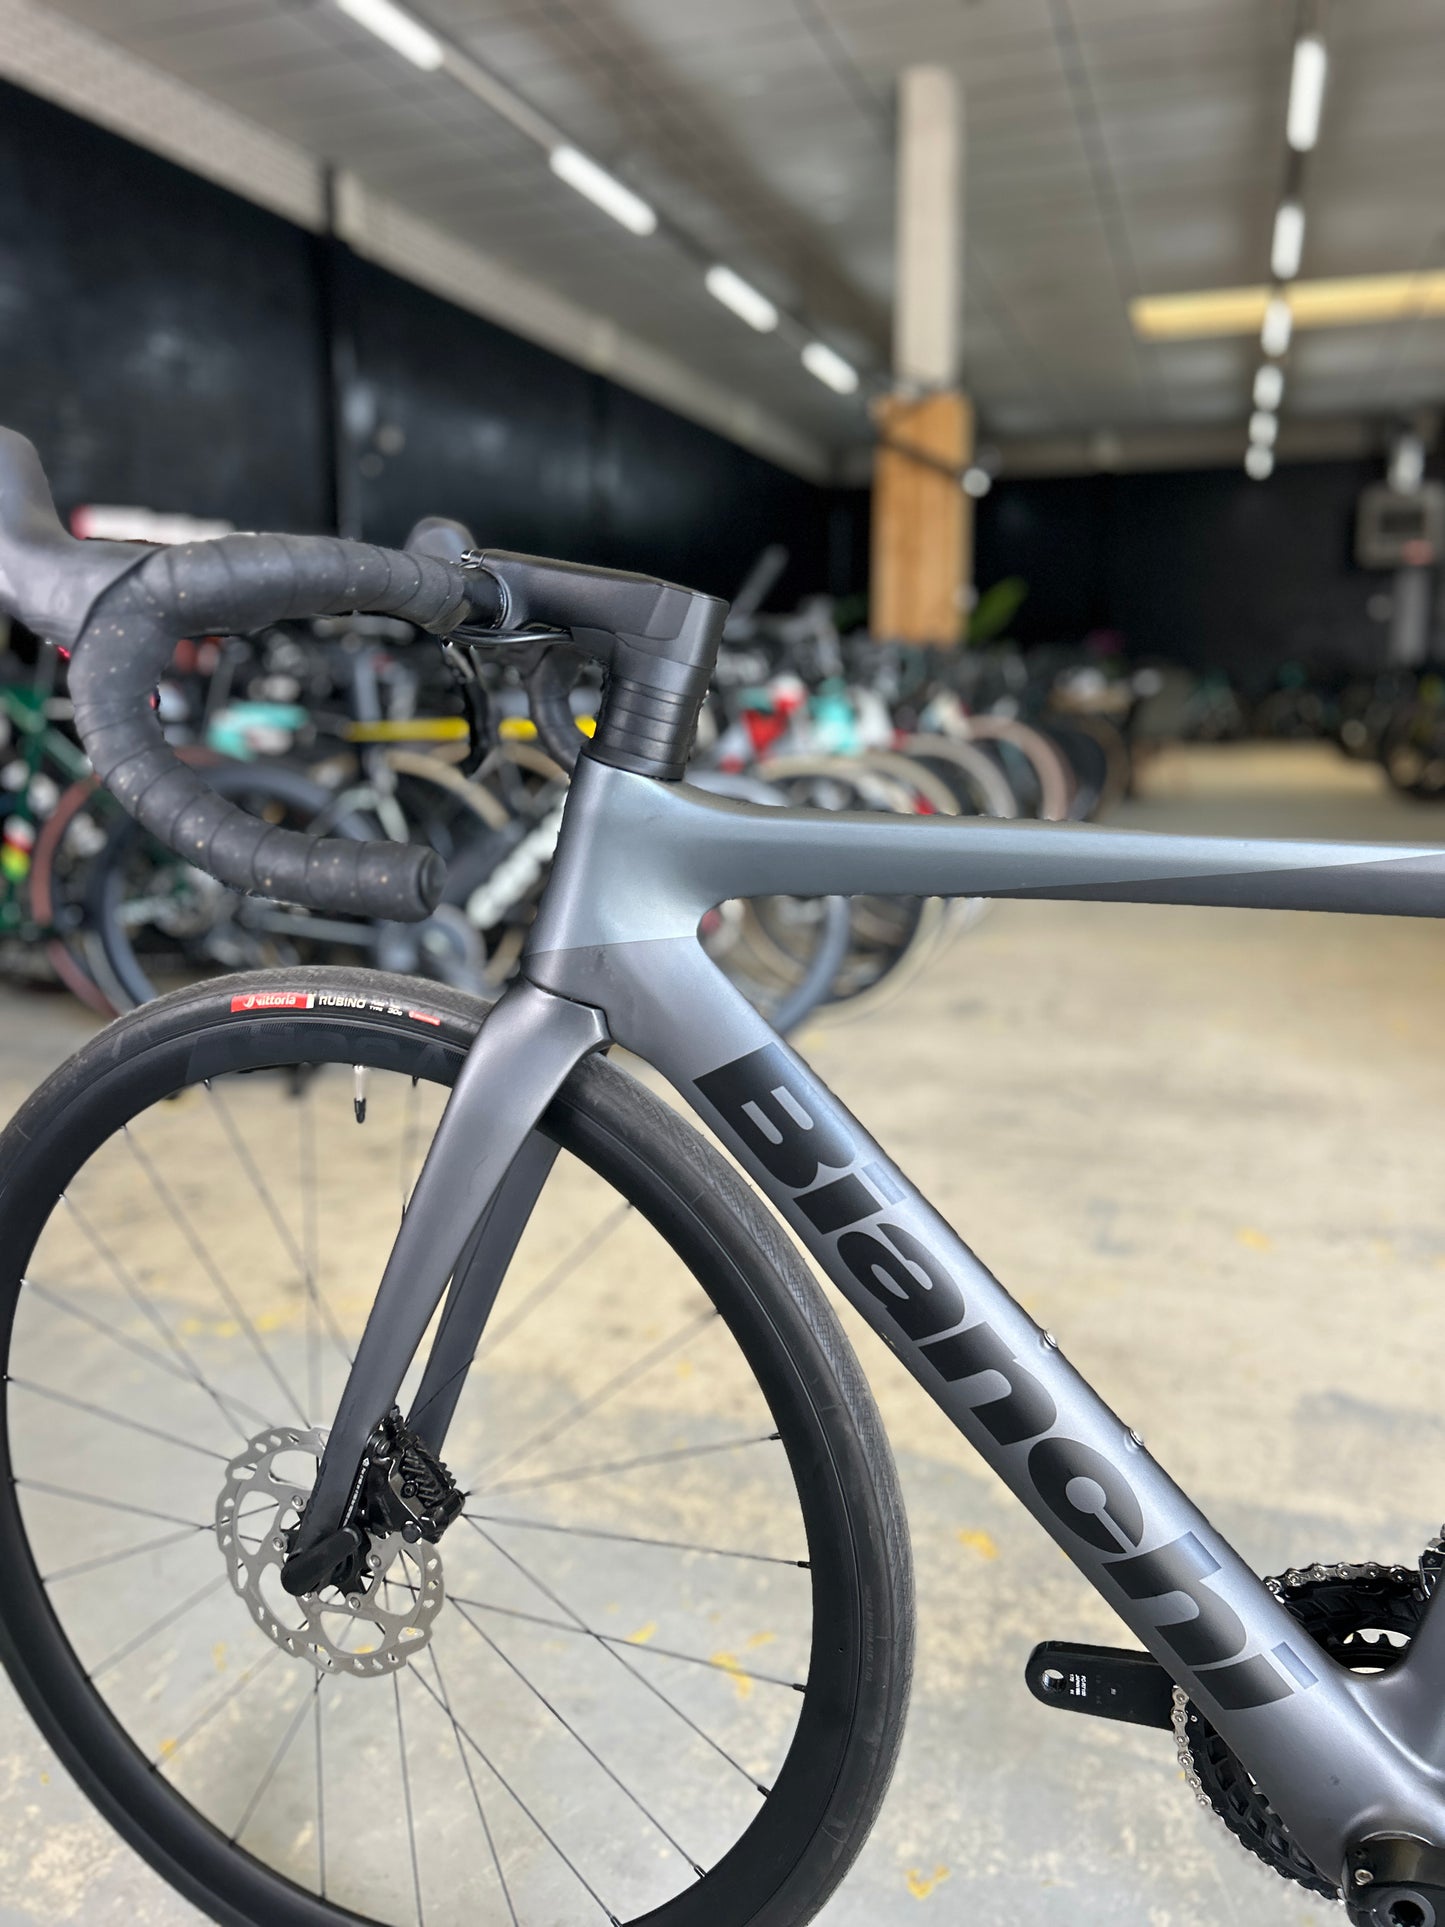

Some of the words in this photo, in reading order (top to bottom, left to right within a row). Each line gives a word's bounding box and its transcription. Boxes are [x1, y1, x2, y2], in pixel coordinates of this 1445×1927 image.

[255, 995, 297, 1007] vittoria
[318, 995, 366, 1009] RUBINO
[693, 1042, 1319, 1710] Bianchi
